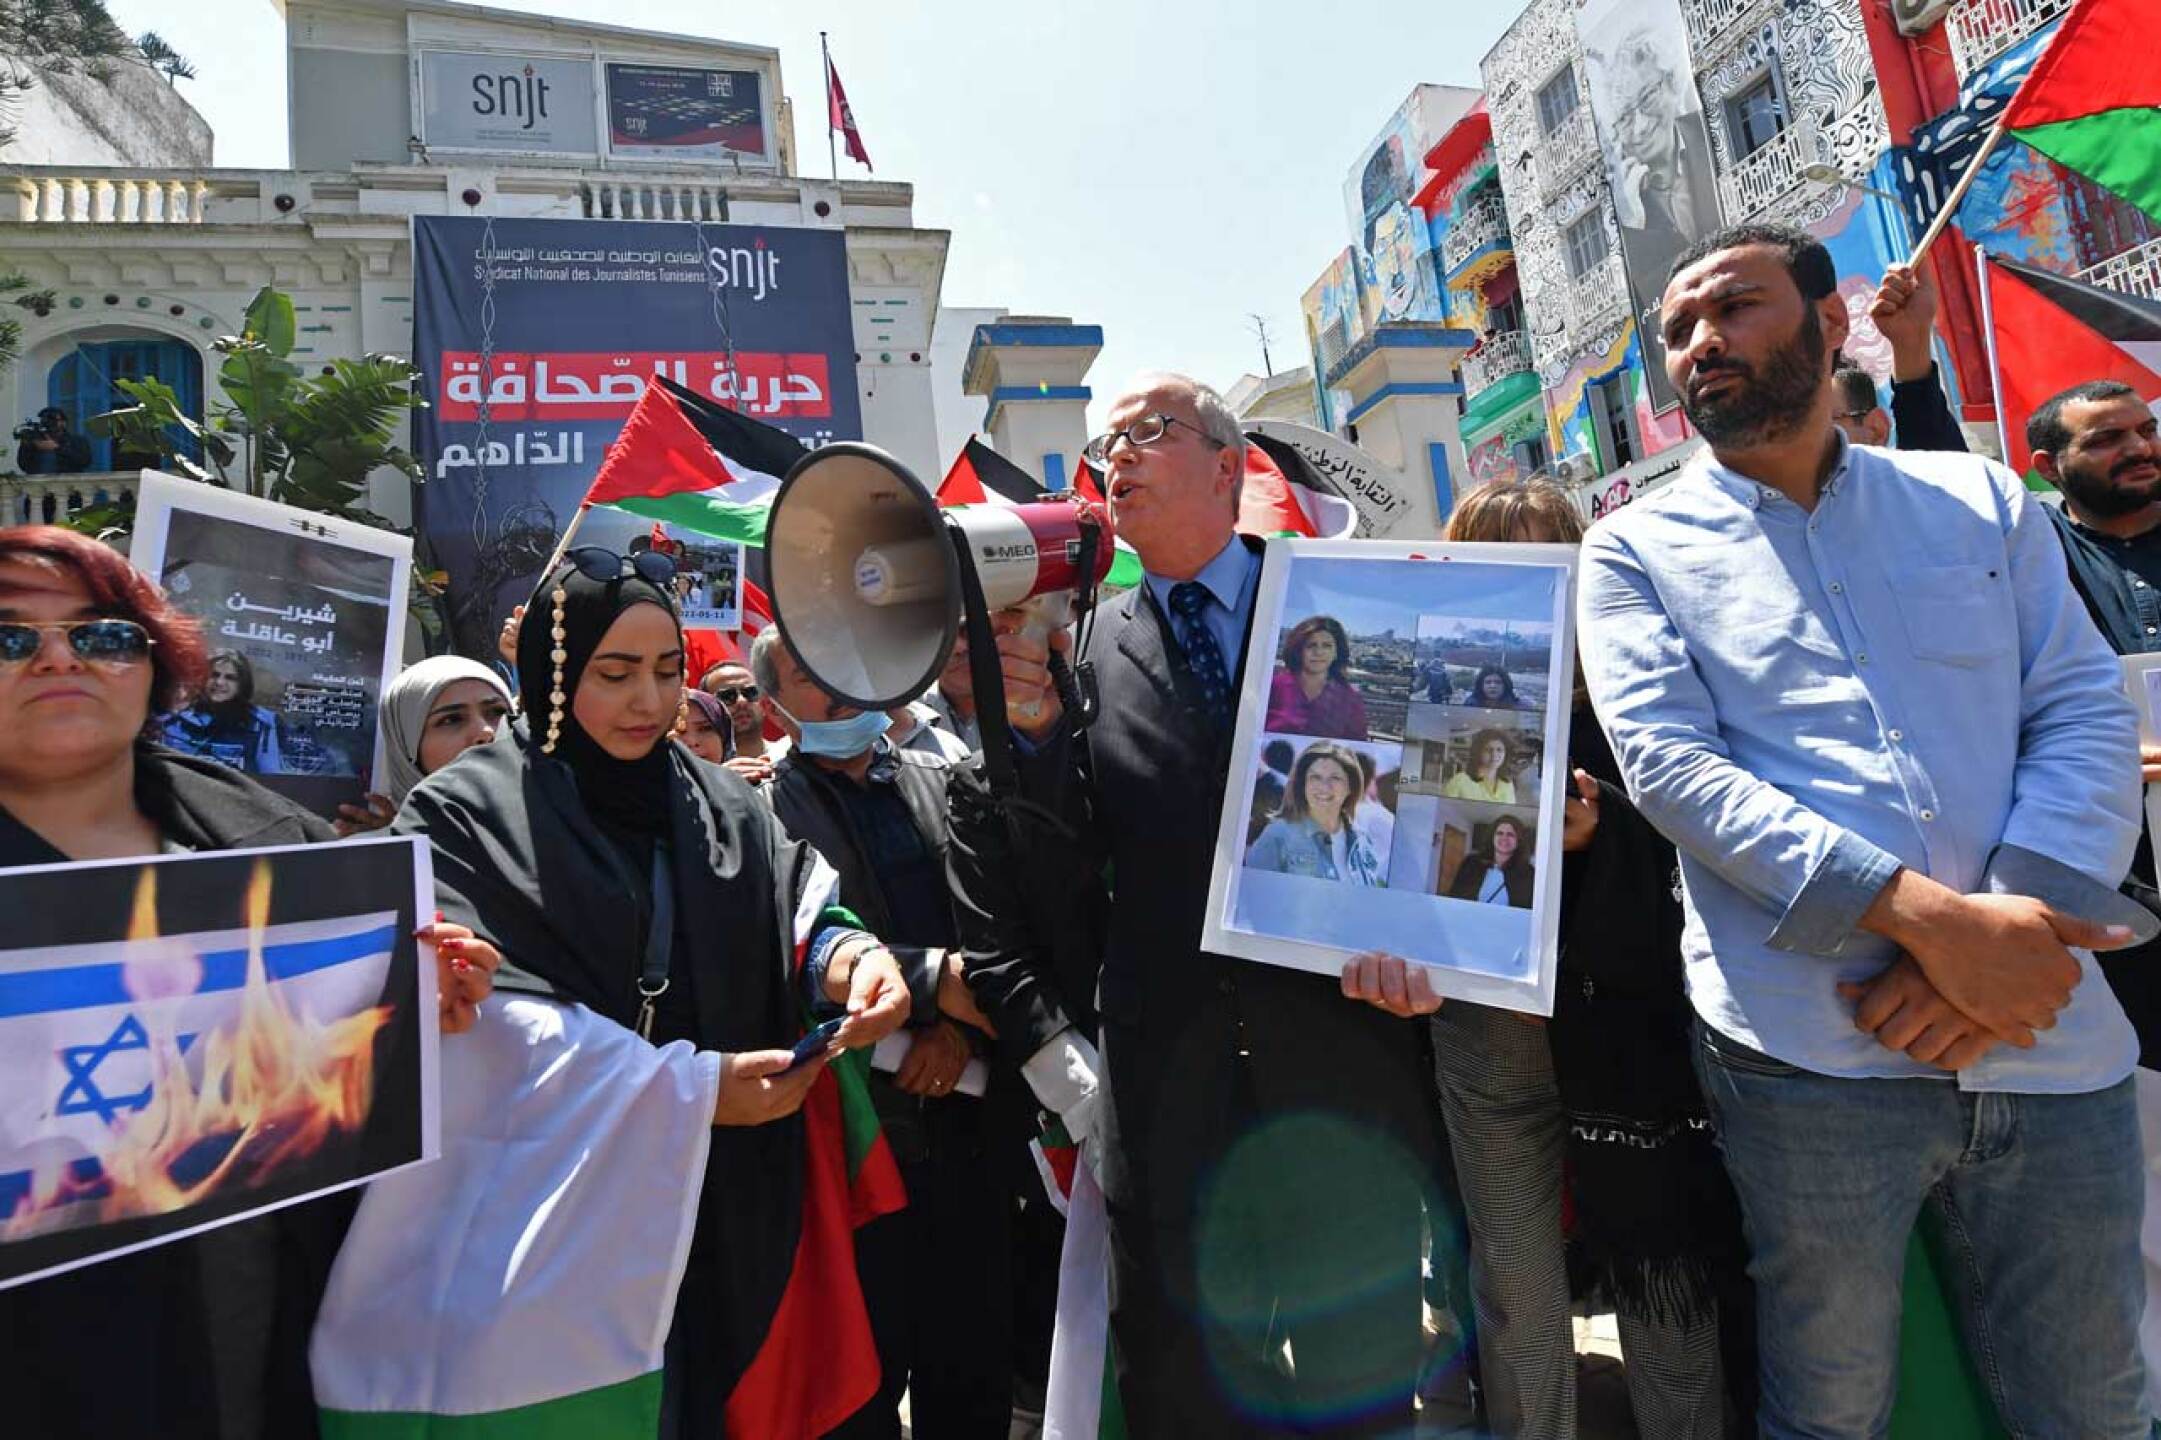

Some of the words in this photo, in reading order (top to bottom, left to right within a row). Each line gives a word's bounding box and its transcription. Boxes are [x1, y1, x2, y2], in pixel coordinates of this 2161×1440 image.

[473, 63, 550, 129] snjt
[473, 264, 521, 281] Sdicat
[524, 265, 570, 281] National
[571, 266, 590, 281] des
[592, 266, 657, 282] Journalistes
[659, 267, 705, 283] Tunisiens
[711, 238, 780, 300] snjt
[710, 360, 823, 412] حرية
[220, 618, 296, 646] عاقلة
